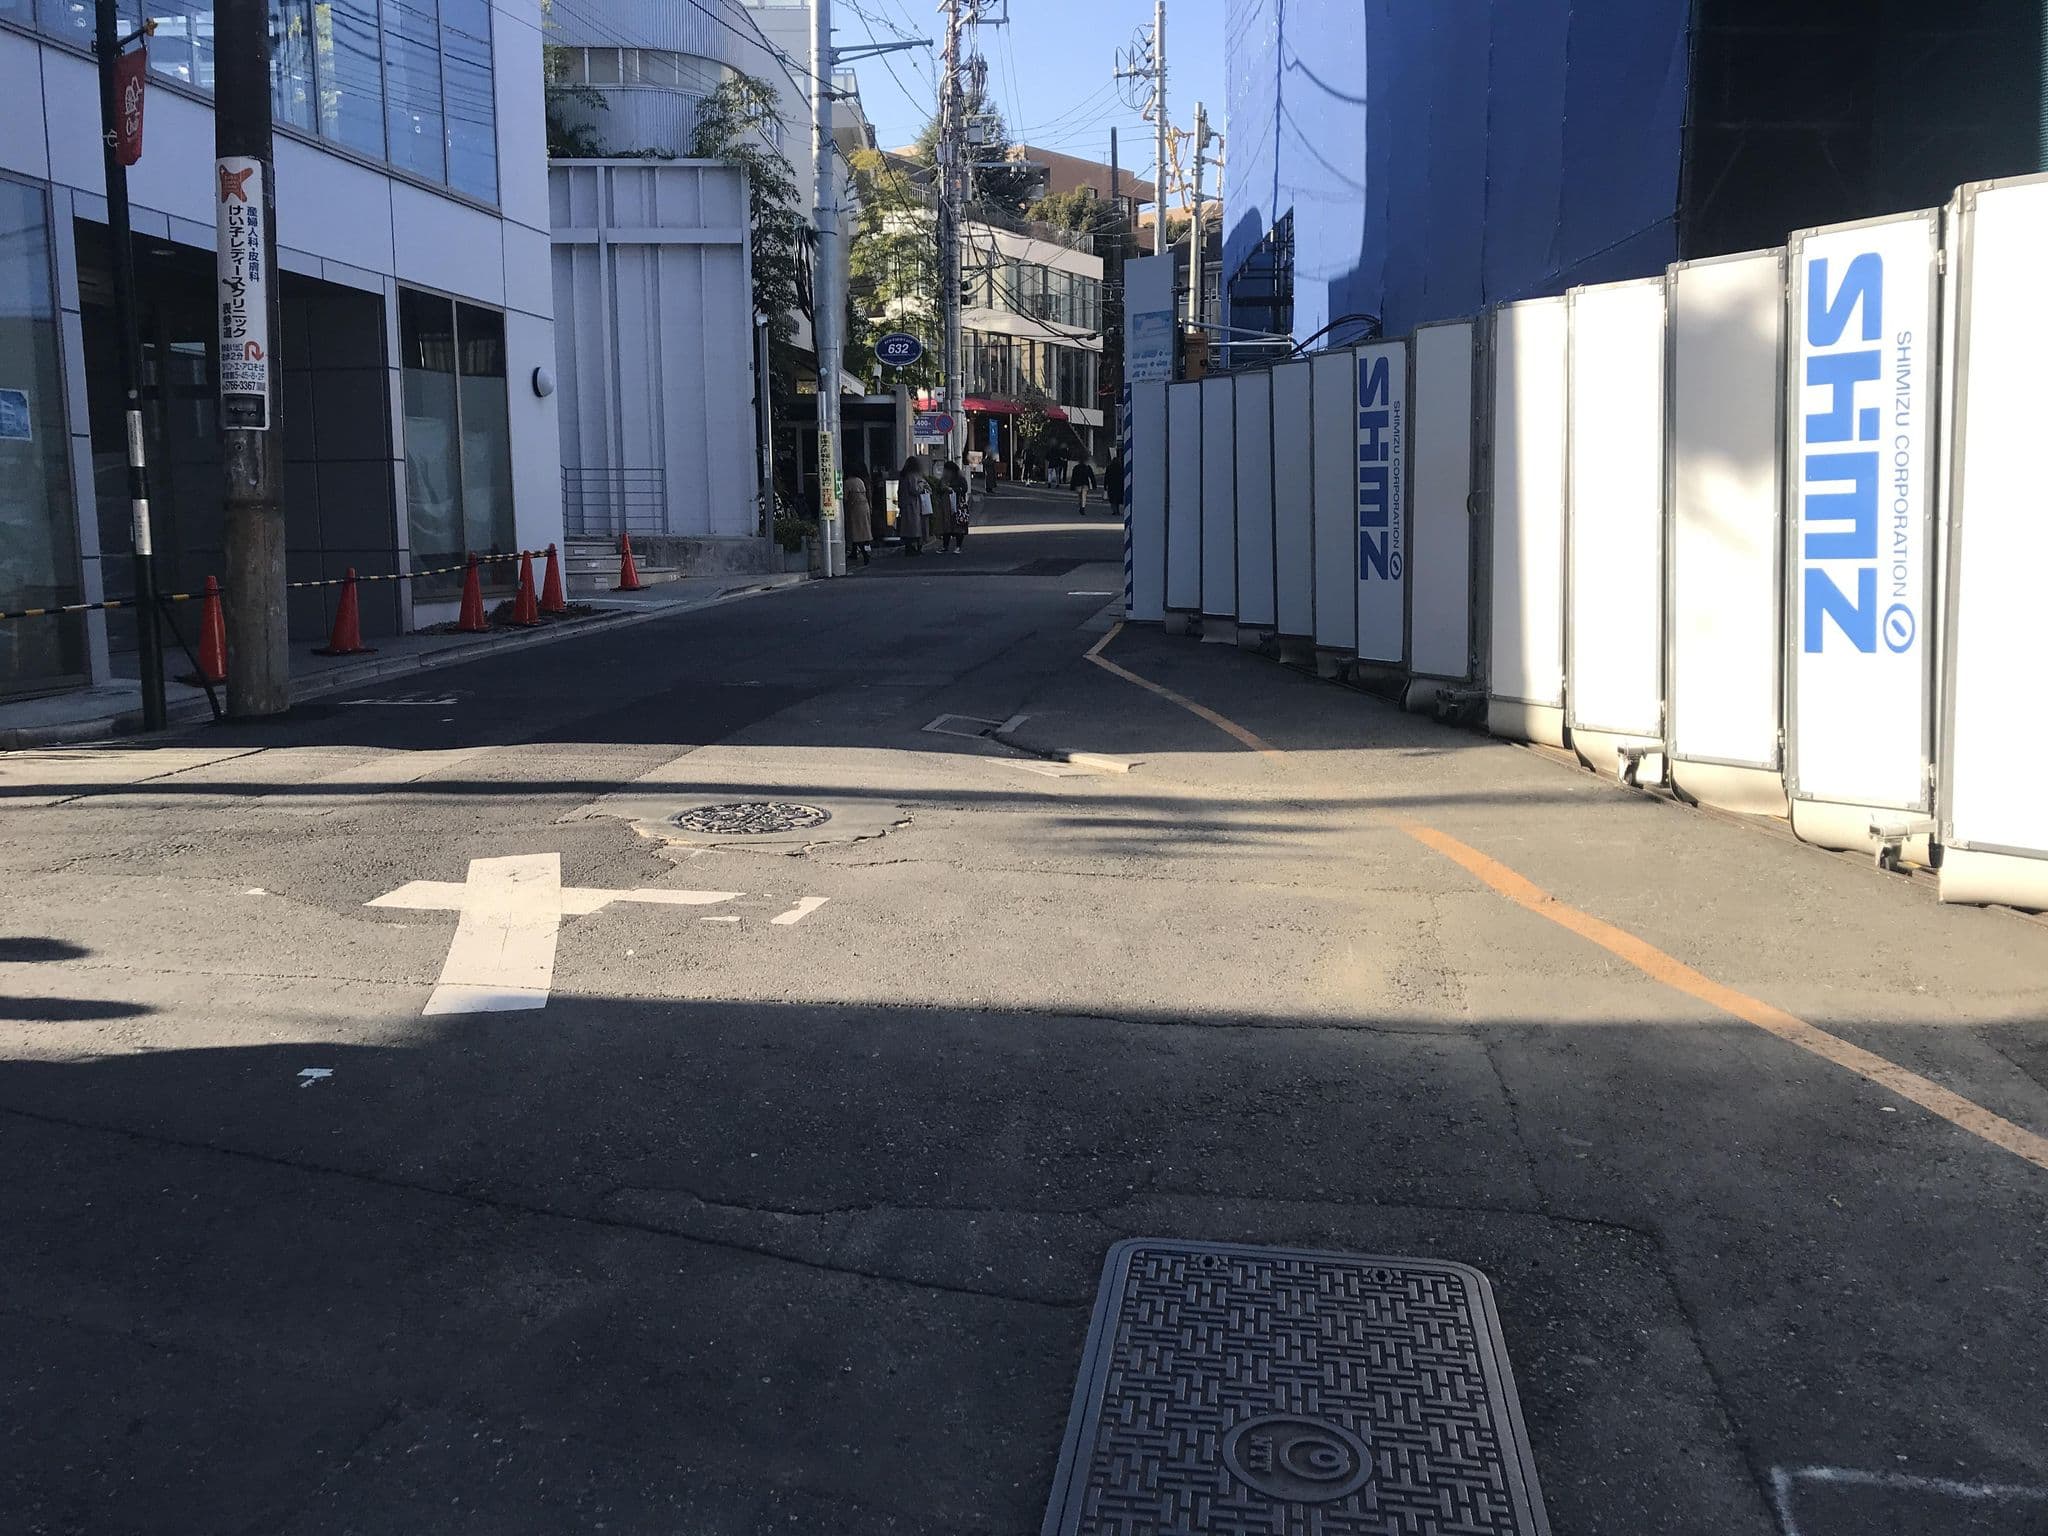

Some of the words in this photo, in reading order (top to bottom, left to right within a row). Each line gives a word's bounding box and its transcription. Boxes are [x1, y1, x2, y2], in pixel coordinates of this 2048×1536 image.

[229, 205, 247, 338] けい子レディースクリニック
[247, 206, 259, 282] 産婦人科・皮膚科
[887, 343, 909, 354] 632
[1896, 331, 1912, 427] SHIMIZU
[1893, 435, 1910, 597] CORPORATION
